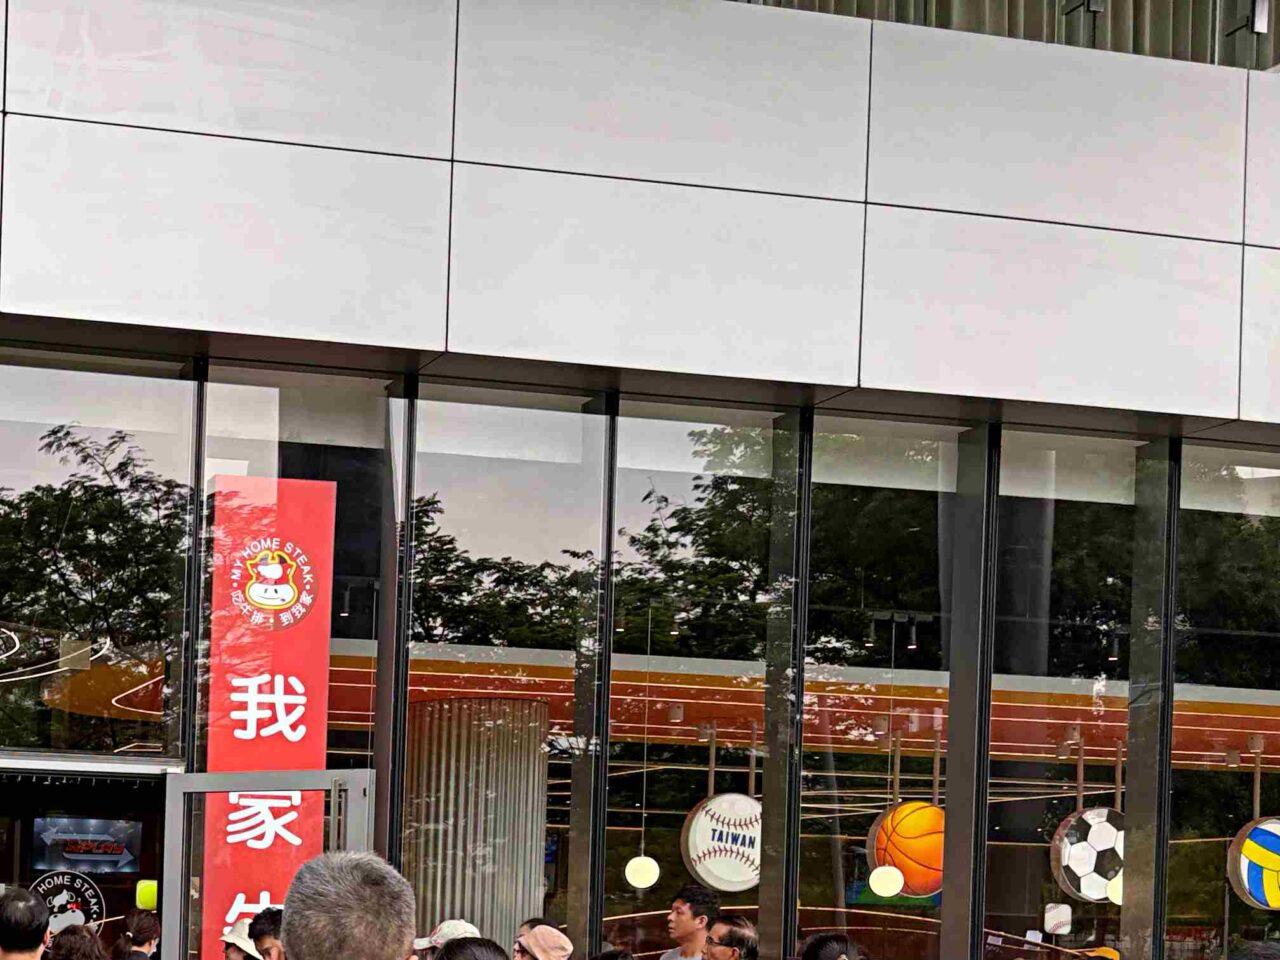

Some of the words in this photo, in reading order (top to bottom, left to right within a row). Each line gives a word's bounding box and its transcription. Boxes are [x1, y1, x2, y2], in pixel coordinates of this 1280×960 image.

[231, 559, 243, 580] MY
[241, 538, 280, 558] HOME
[284, 542, 313, 583] STEAK
[231, 590, 264, 624] 吃牛排
[279, 591, 314, 626] 到我家
[711, 828, 756, 849] TAIWAN
[37, 875, 71, 894] HOME
[74, 878, 100, 914] STEAK
